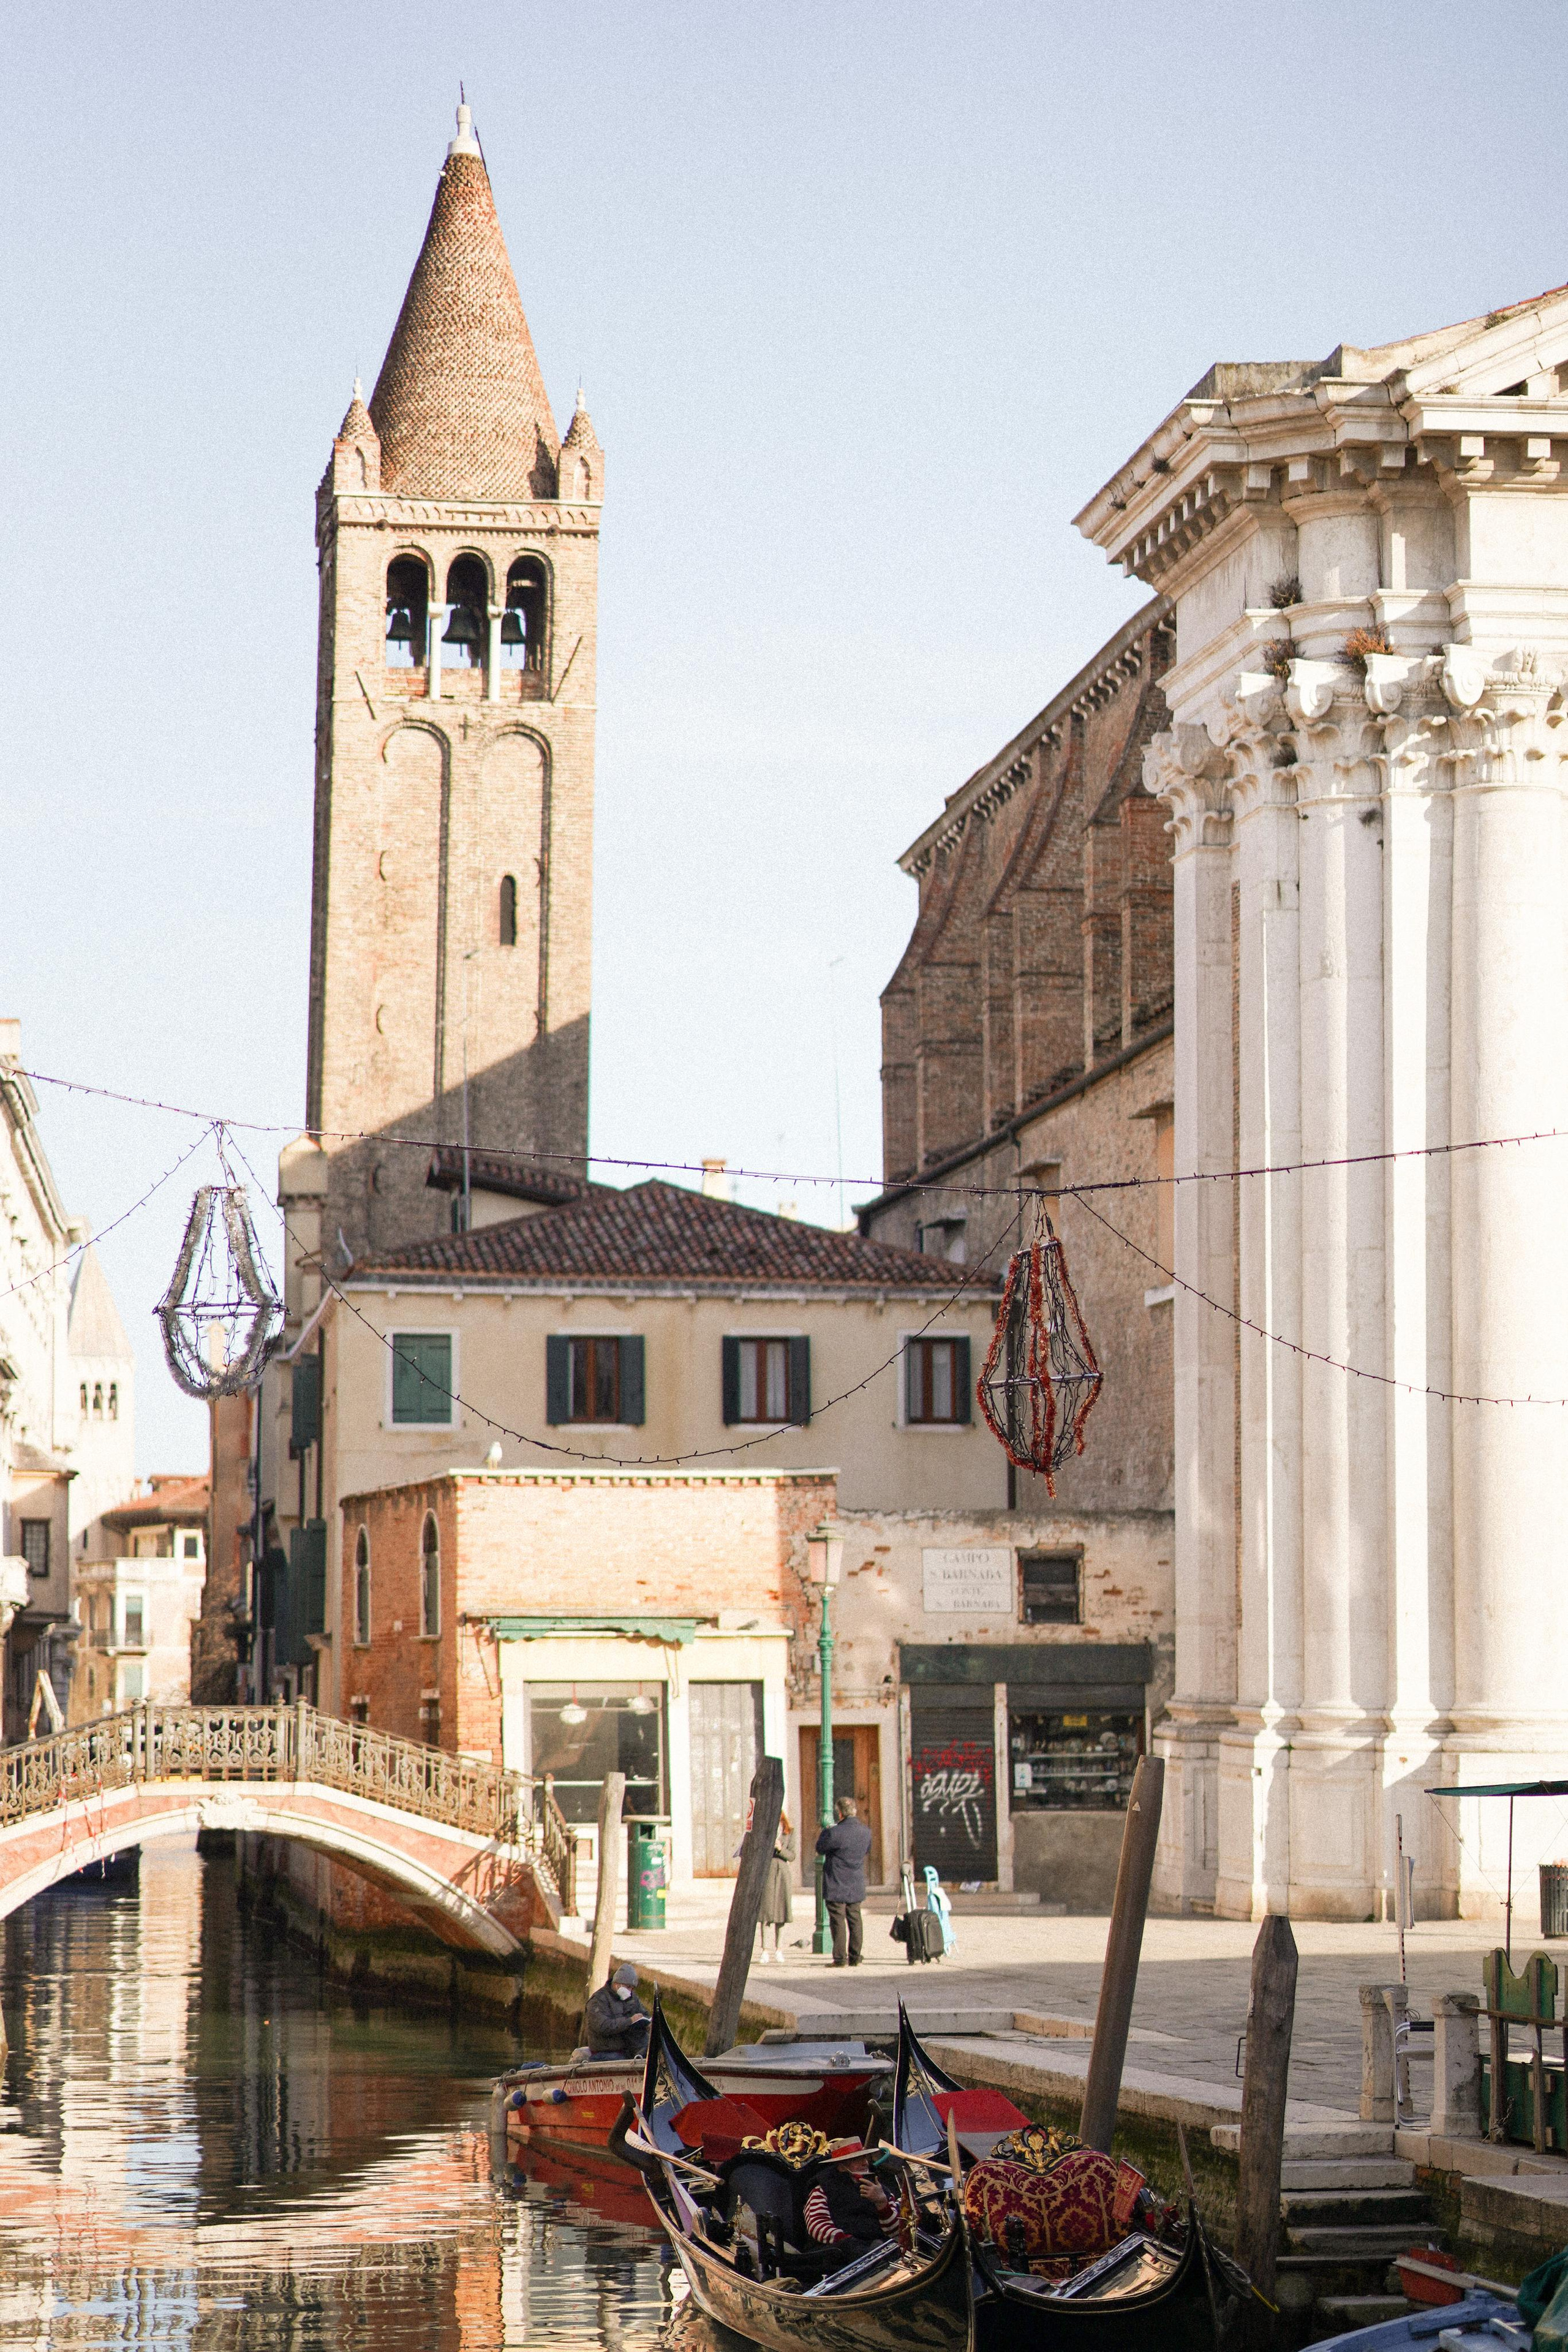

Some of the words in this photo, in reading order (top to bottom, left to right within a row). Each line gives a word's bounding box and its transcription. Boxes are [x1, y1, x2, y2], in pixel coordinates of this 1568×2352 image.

[943, 1553, 990, 1562] CAMPO
[942, 1569, 1001, 1579] BARNABA
[953, 1600, 1001, 1608] BARNABA
[564, 2079, 587, 2094] ONIOLO
[589, 2078, 614, 2092] ANTONIO
